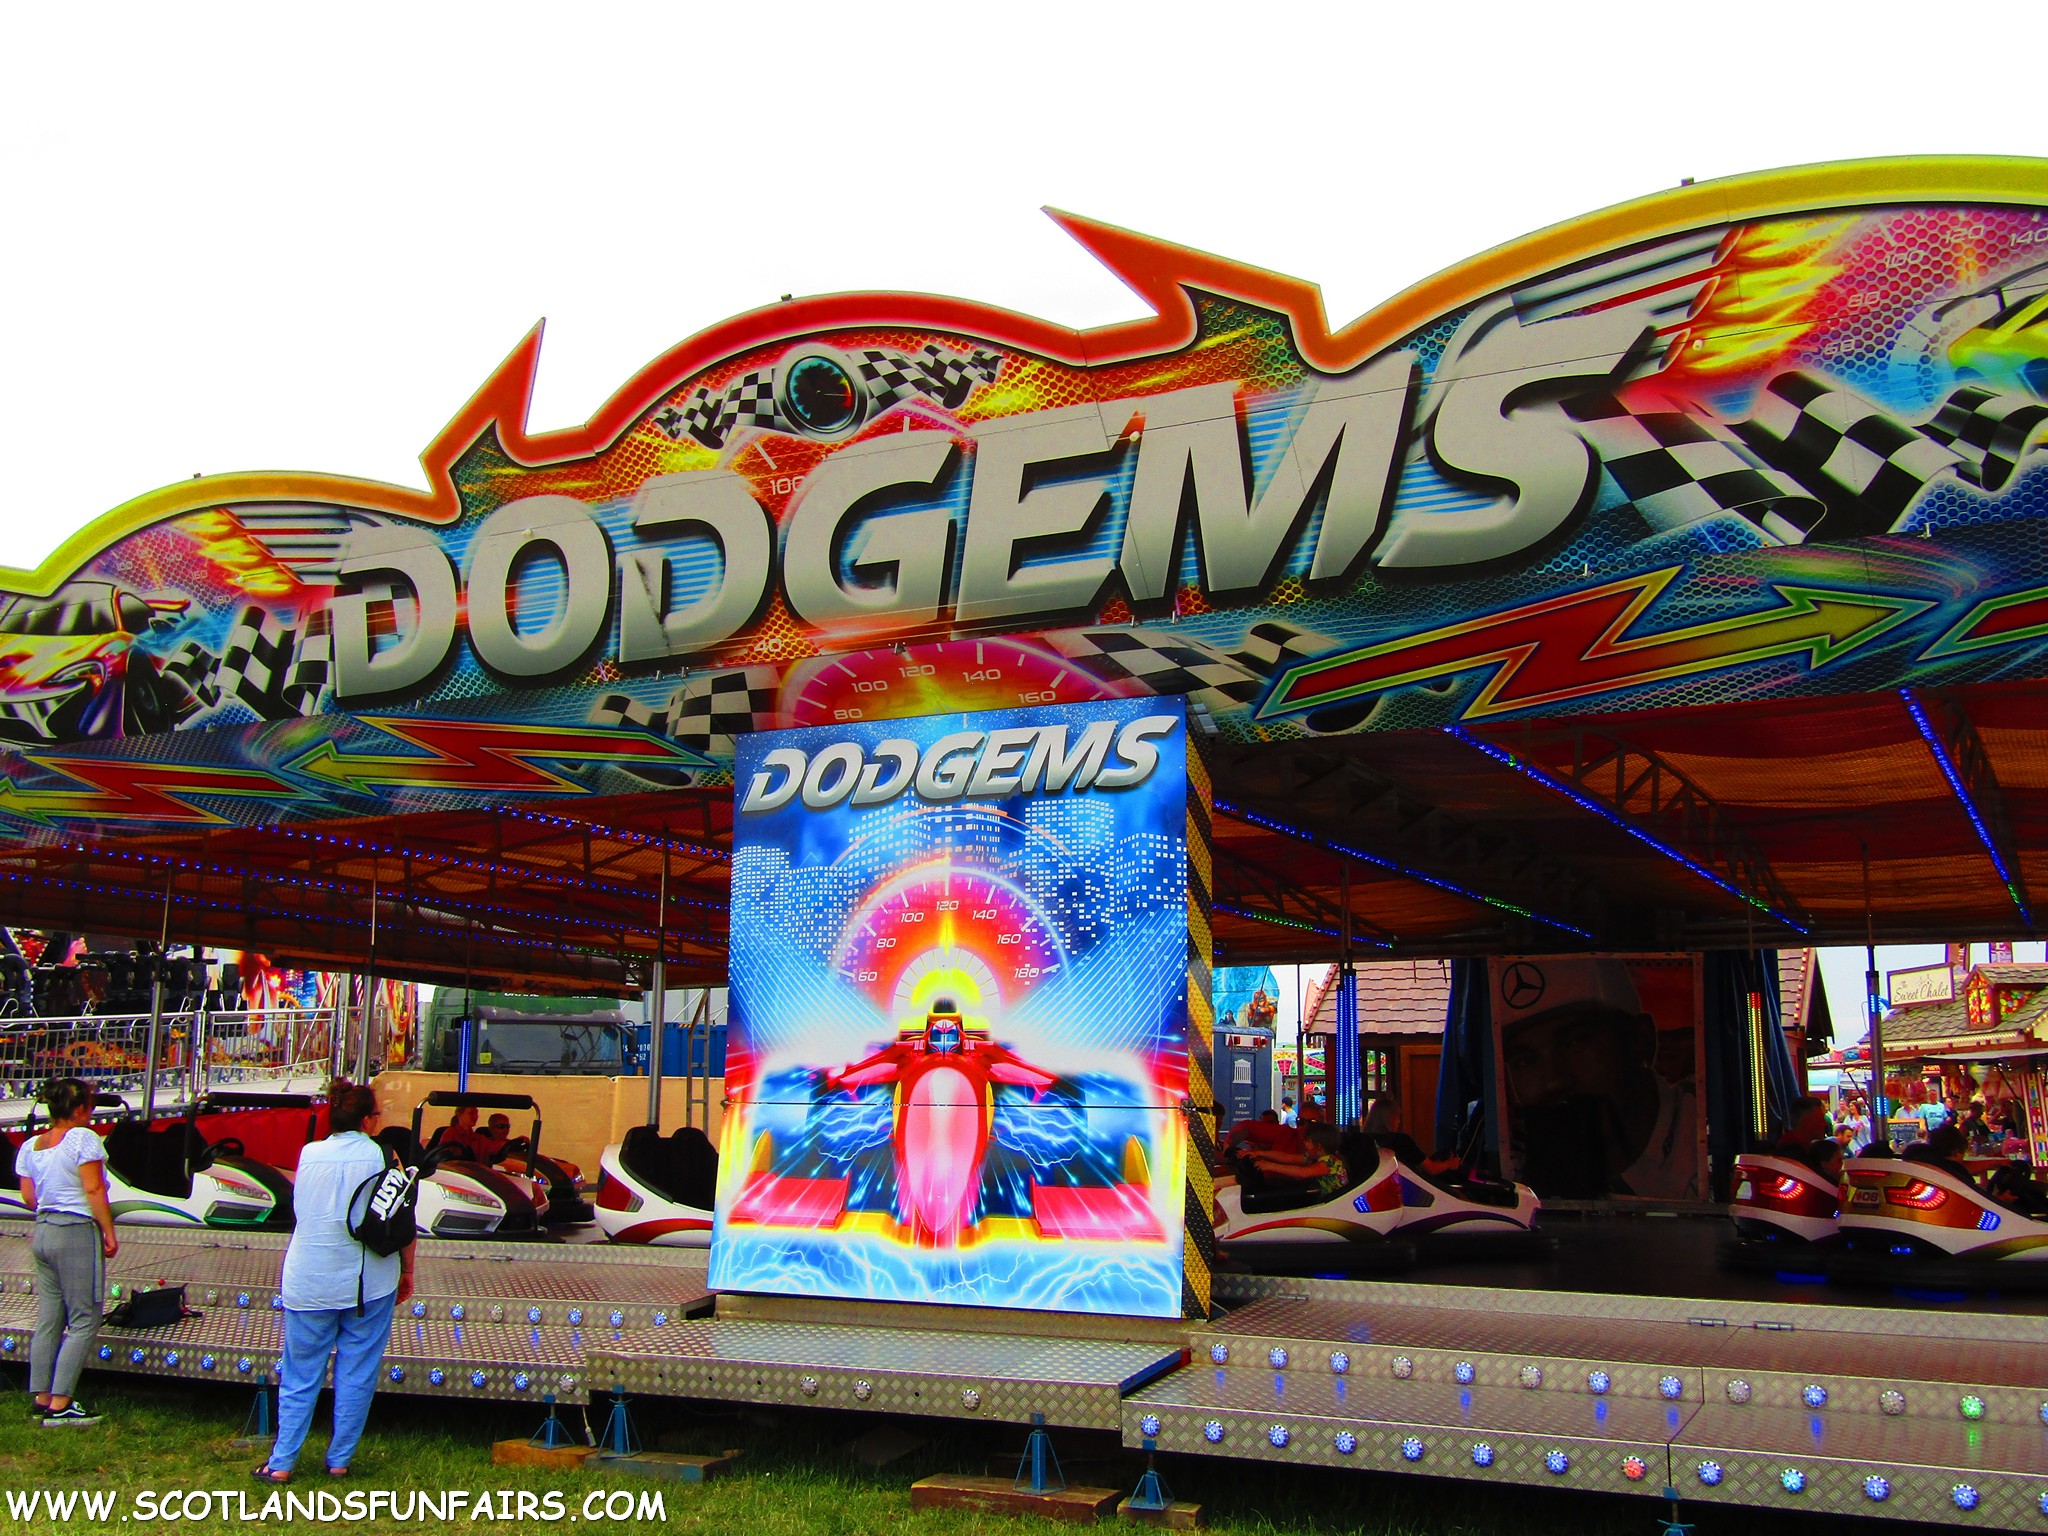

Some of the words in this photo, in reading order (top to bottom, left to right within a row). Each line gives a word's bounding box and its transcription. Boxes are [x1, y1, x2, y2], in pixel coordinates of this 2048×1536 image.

[331, 305, 1652, 698] DODGEMS
[899, 664, 936, 678] 120
[963, 669, 1001, 682] 140
[851, 680, 888, 693] 100
[1018, 690, 1056, 703] 160
[834, 708, 863, 720] 80
[741, 715, 1180, 813] DODGEMS
[936, 900, 959, 911] 120
[901, 912, 925, 923] 100
[972, 909, 997, 921] 140
[876, 938, 896, 949] 80
[996, 933, 1021, 945] 160
[858, 971, 878, 982] 60
[1894, 987, 1918, 1002] Sweet
[1920, 981, 1949, 999] Chalet
